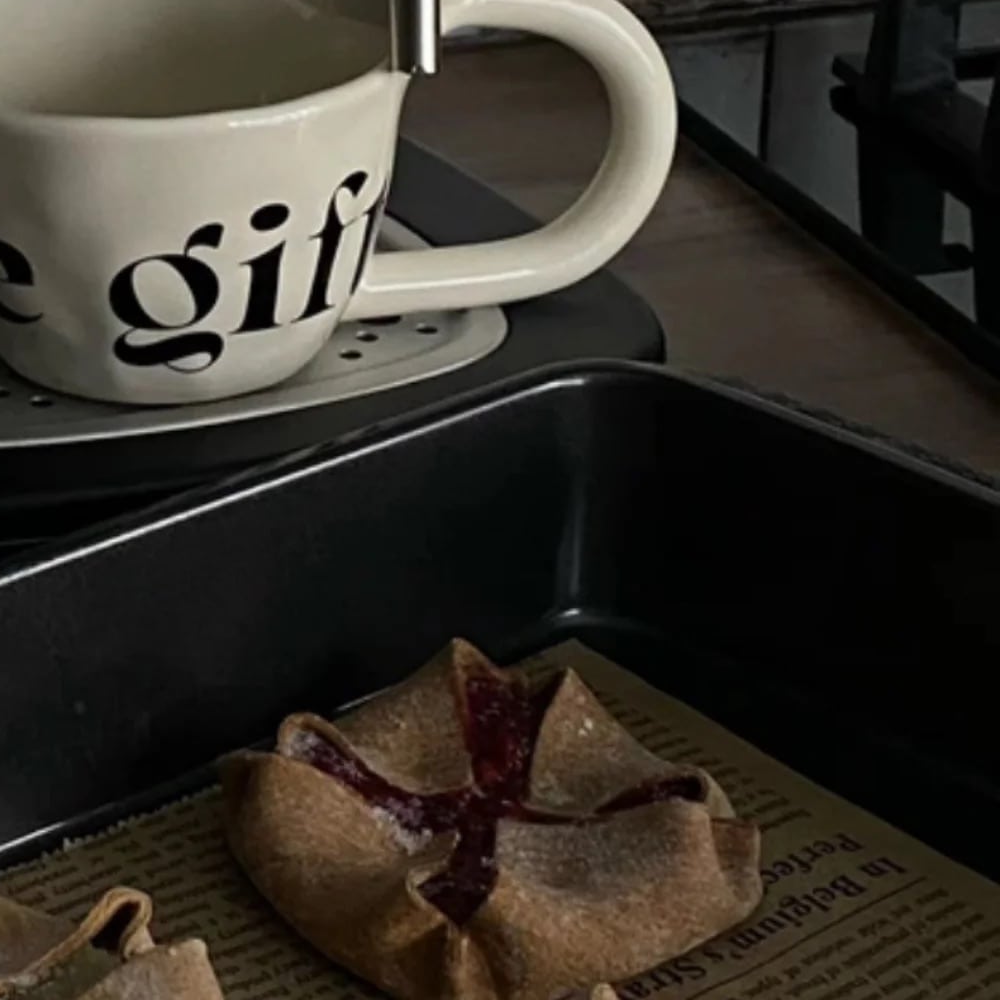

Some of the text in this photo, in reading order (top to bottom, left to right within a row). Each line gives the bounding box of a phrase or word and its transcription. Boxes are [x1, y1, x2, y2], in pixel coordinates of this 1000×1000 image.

[760, 832, 864, 885] Perfec
[860, 857, 907, 876] In
[702, 875, 868, 962] Belgium's
[617, 956, 707, 1000] Stra
